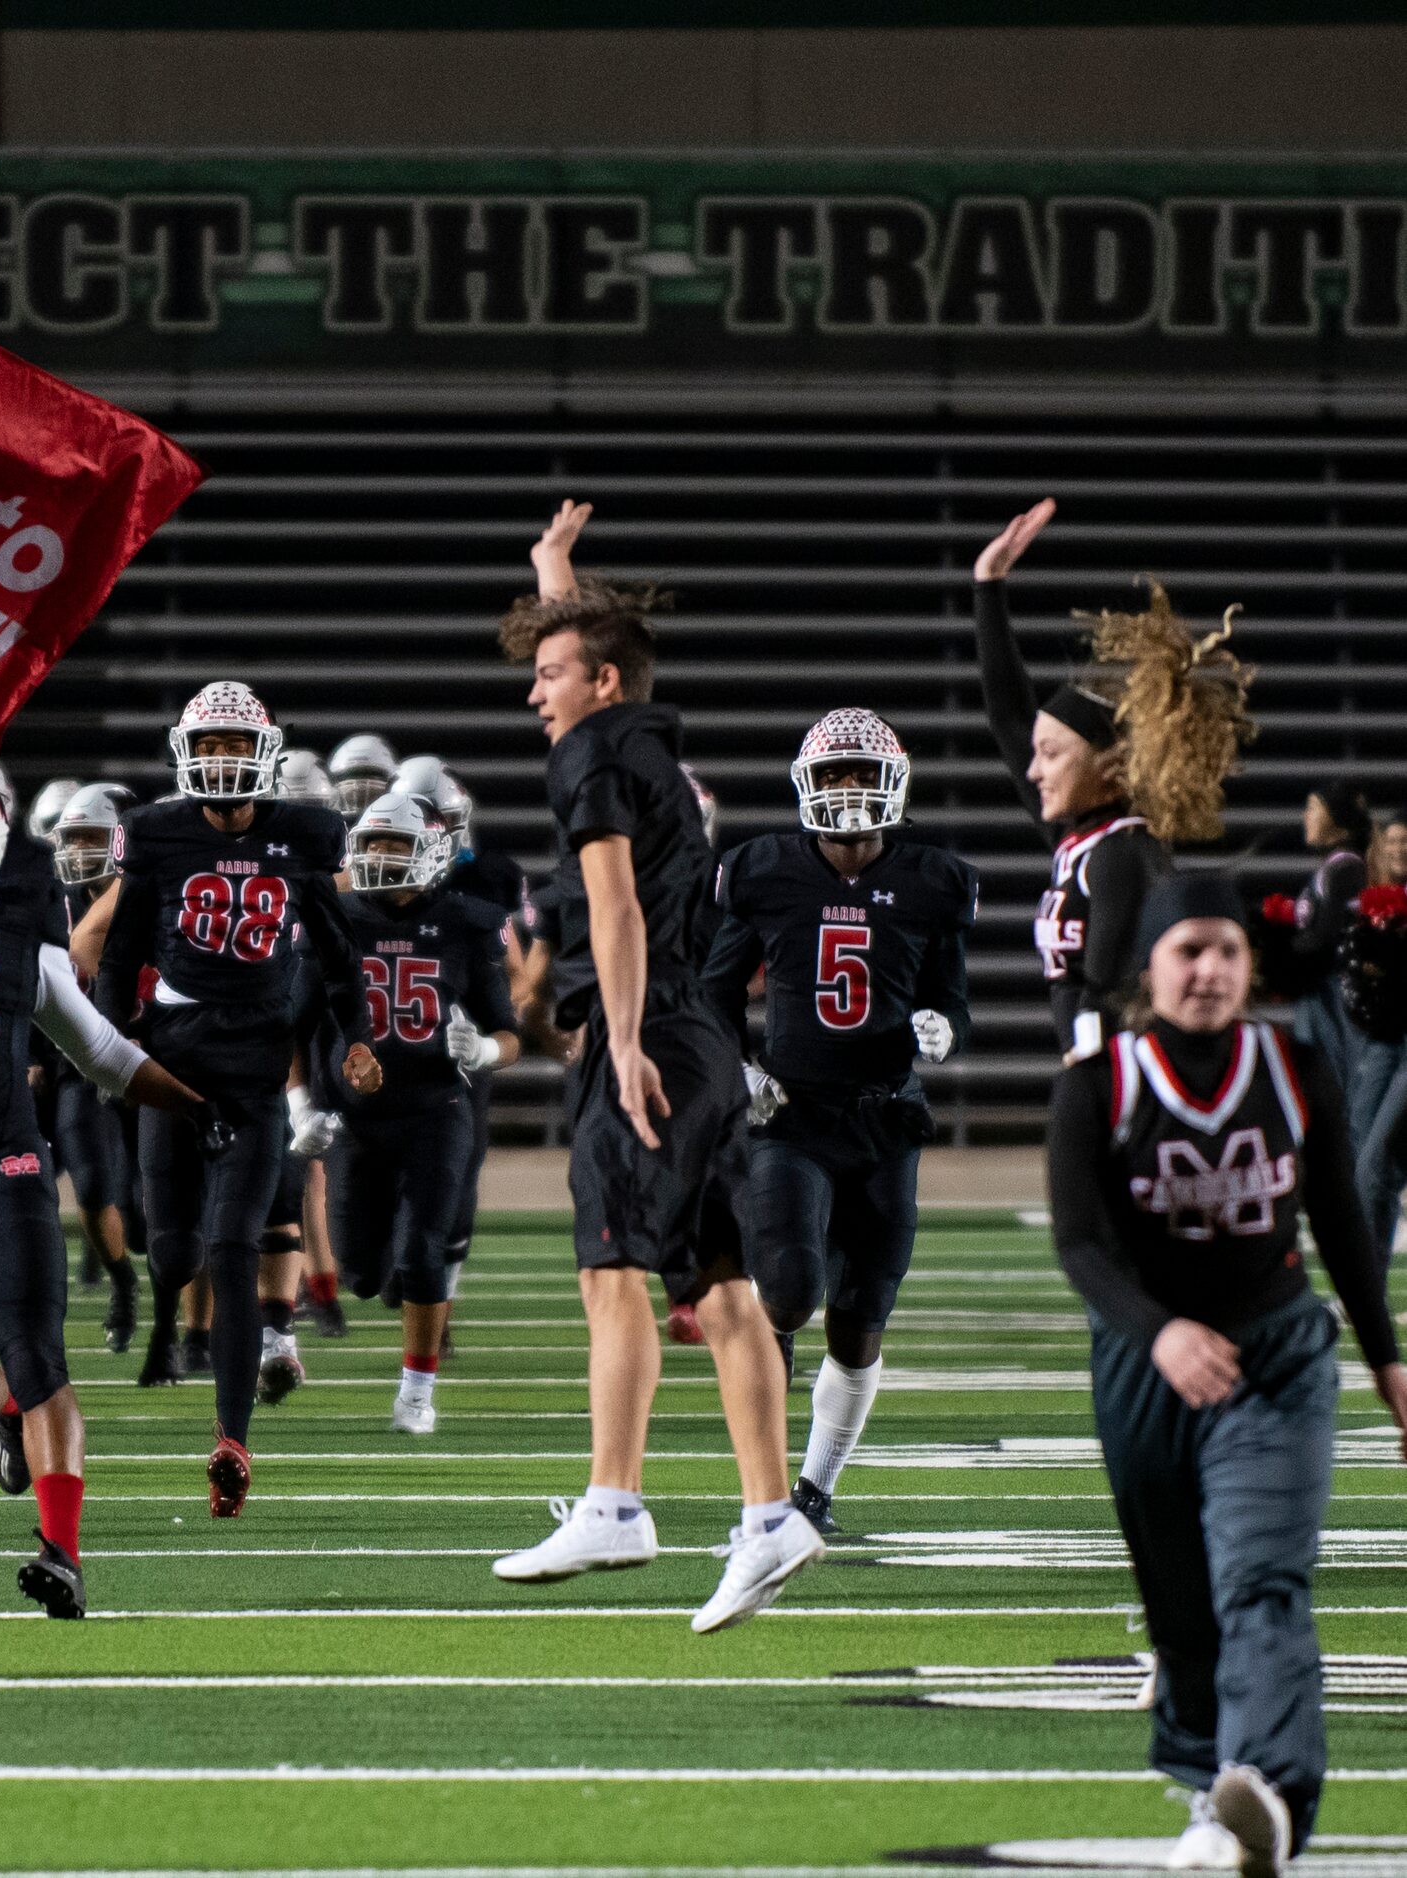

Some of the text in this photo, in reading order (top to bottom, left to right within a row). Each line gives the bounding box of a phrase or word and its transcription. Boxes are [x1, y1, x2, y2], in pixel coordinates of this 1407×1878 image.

[294, 194, 648, 333] THE
[216, 860, 259, 874] CARDS
[178, 872, 288, 961] 88
[822, 905, 867, 922] CARDS
[815, 924, 871, 1030] 5
